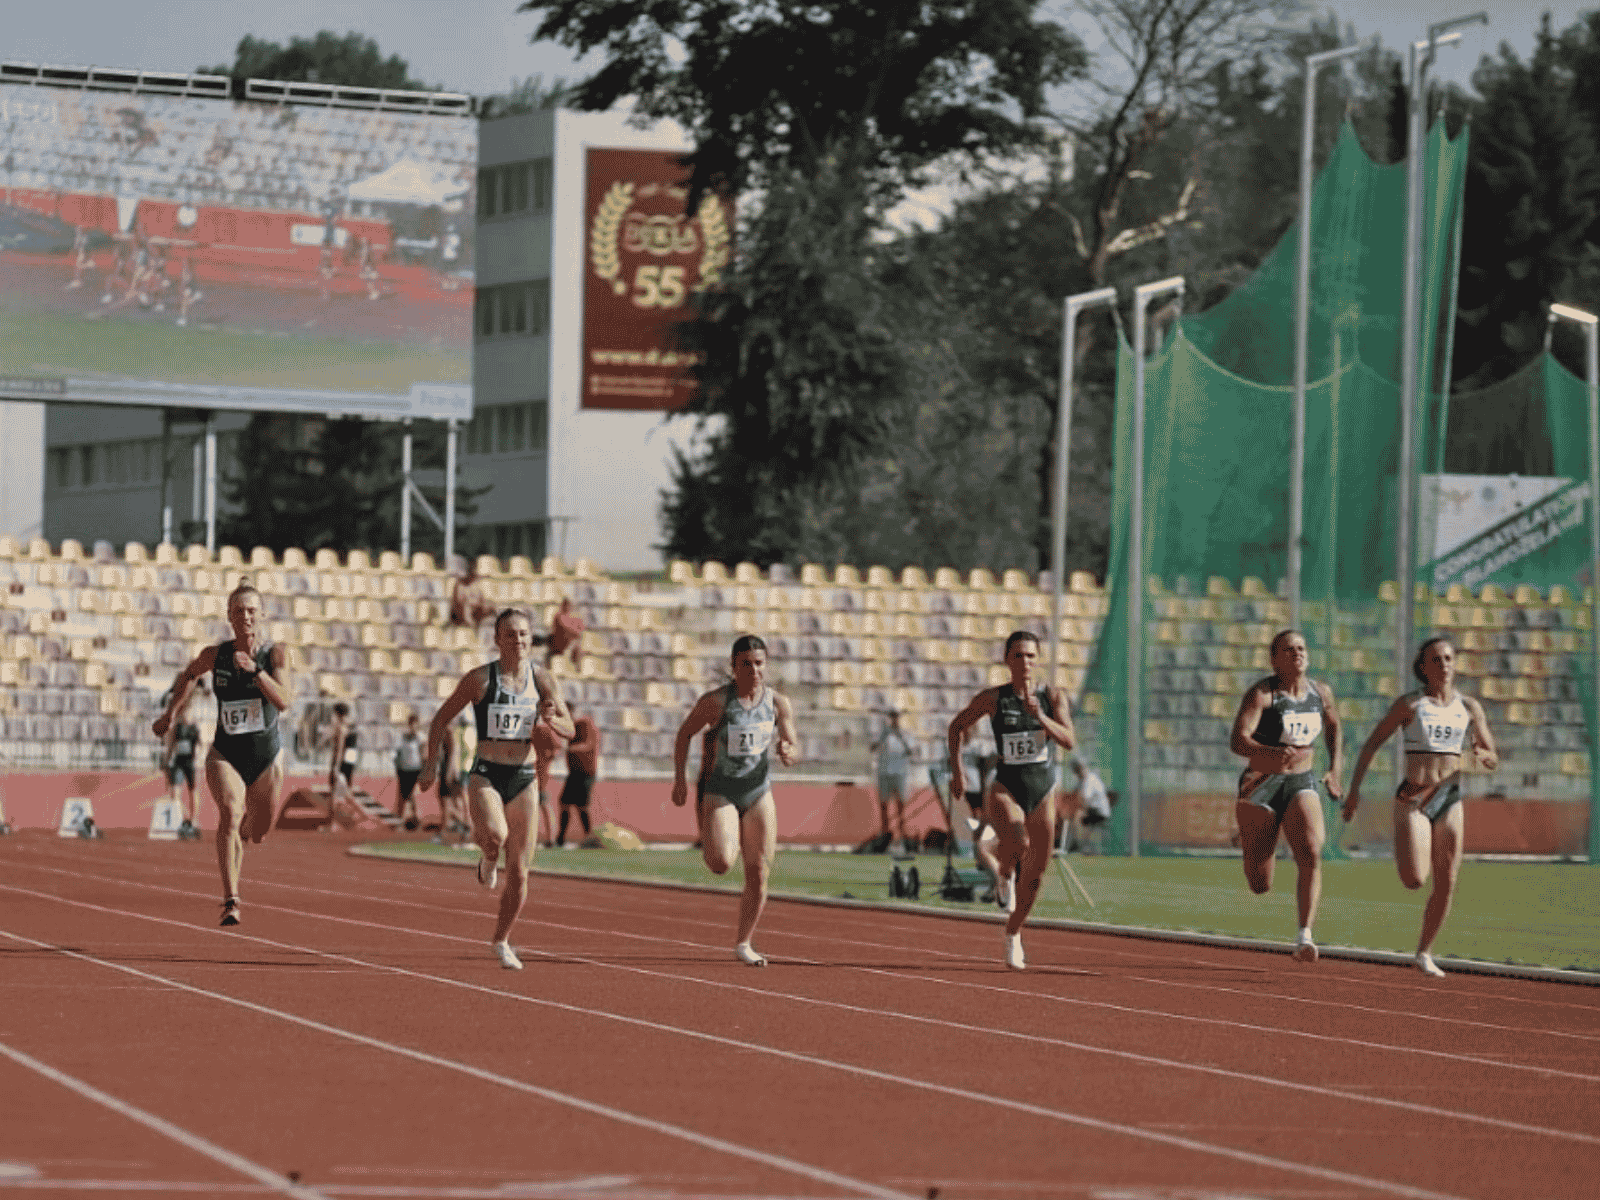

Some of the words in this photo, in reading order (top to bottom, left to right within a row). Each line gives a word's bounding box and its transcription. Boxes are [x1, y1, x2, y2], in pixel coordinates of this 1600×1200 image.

[633, 265, 686, 308] 55
[223, 709, 248, 725] 167
[495, 713, 520, 729] 187
[1428, 724, 1452, 740] 169
[1009, 740, 1035, 756] 162
[70, 804, 85, 826] 2
[161, 807, 173, 828] 1
